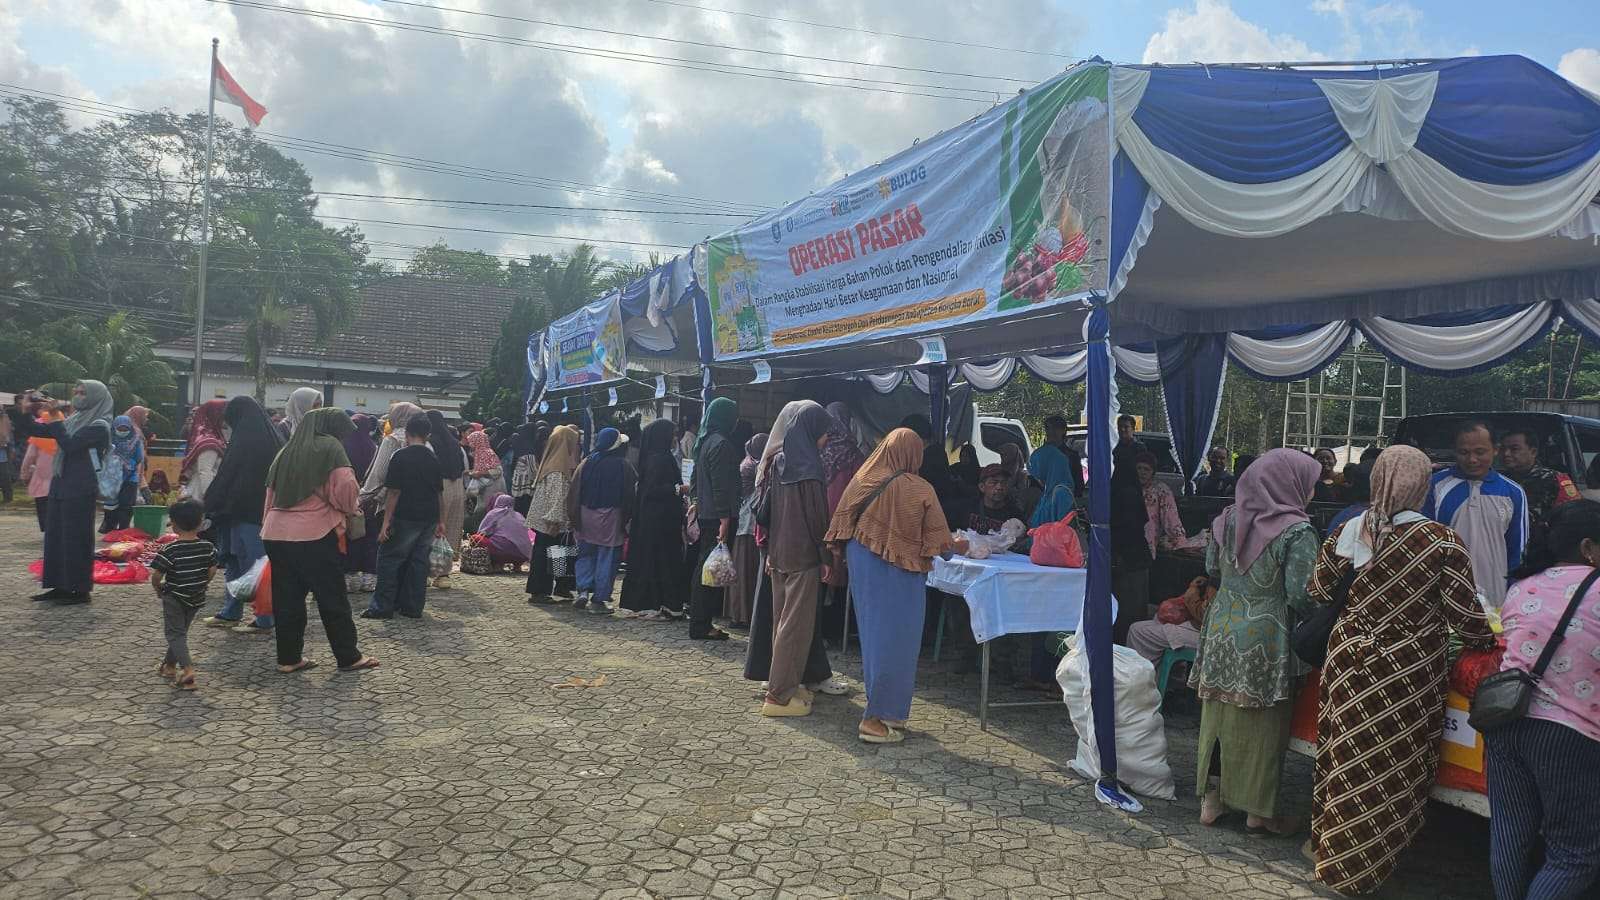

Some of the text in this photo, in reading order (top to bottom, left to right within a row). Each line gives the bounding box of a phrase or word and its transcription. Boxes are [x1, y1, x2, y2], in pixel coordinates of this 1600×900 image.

[890, 165, 927, 193] BULOG
[788, 228, 856, 276] OPERASI
[856, 203, 927, 256] PASAR
[755, 295, 774, 307] Dalam
[774, 289, 795, 304] Rangka
[796, 280, 826, 298] Stabilisasi
[826, 276, 846, 290] Harga
[846, 270, 869, 285] Bahan
[869, 261, 894, 279] Pokok
[895, 259, 912, 273] dan
[912, 240, 972, 268] Pengendalian
[785, 264, 959, 318] Menghadapi Hari Besar Keagamaan dan Nasional
